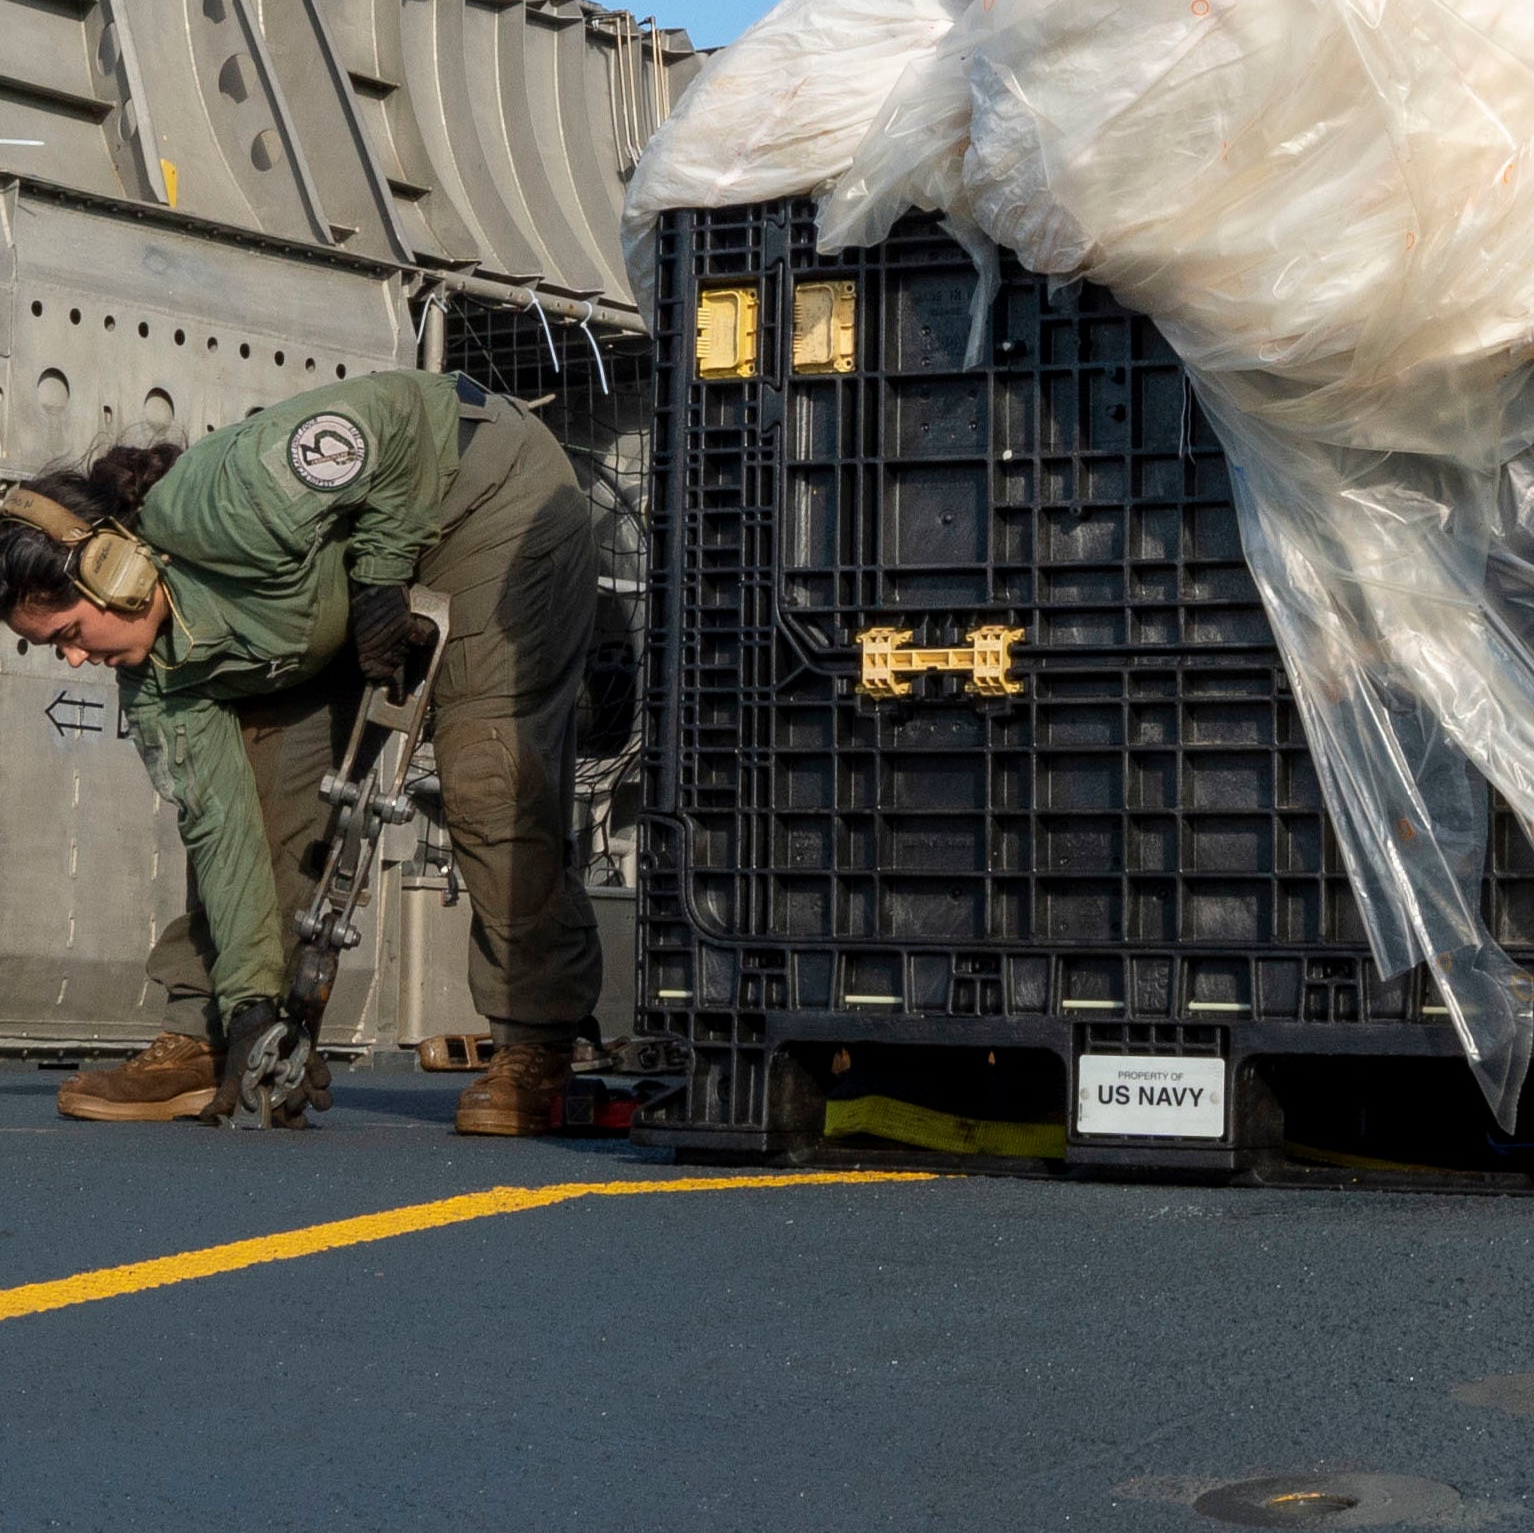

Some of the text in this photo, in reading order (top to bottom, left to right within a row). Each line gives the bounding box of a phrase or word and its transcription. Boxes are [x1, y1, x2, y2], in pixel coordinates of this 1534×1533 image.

[1118, 1070, 1184, 1081] PROPERTY OF
[1098, 1084, 1204, 1107] US NAVY
